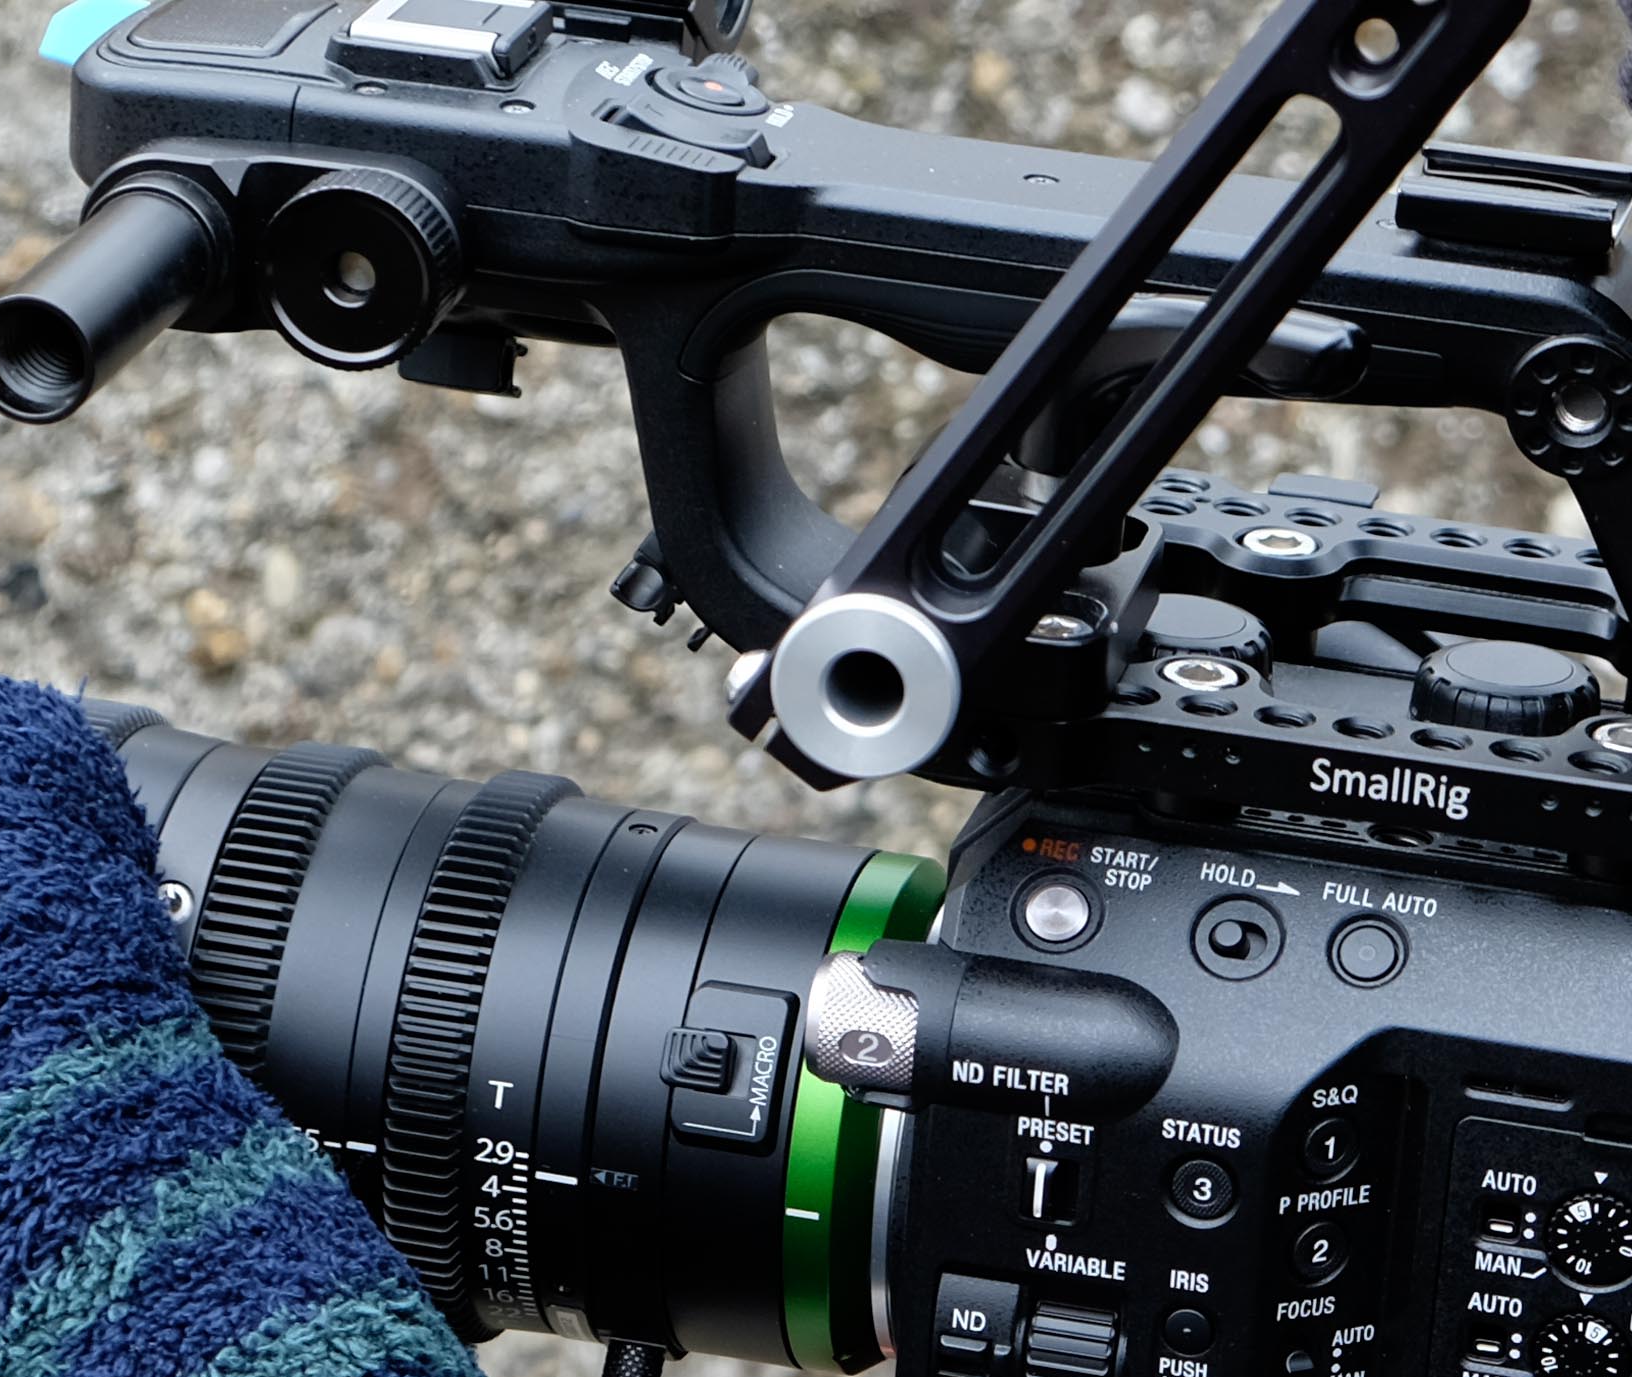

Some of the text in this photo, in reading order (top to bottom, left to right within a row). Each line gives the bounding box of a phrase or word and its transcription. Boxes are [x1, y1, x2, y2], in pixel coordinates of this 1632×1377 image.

[1309, 757, 1471, 820] SmallRig
[1039, 837, 1080, 861] REC
[1090, 846, 1159, 869] START/
[1104, 869, 1153, 892] STOP
[1200, 861, 1256, 888] HOLD
[1322, 881, 1438, 918] FULL AUTO
[857, 1033, 879, 1062] 2
[748, 1035, 777, 1106] MACRO
[952, 1061, 1069, 1096] ND FILTER
[487, 1079, 515, 1110] T
[1311, 1084, 1359, 1109] S&Q
[291, 1126, 321, 1153] 5
[1017, 1116, 1095, 1146] PRESET
[1161, 1118, 1241, 1149] STATUS
[1324, 1136, 1336, 1160] 1
[481, 1174, 501, 1198] 4
[1192, 1177, 1212, 1201] 3
[1481, 1169, 1537, 1196] AUTO
[1279, 1184, 1371, 1215] P PROFILE
[473, 1206, 514, 1231] 5.6
[485, 1238, 504, 1258] 8
[1311, 1239, 1329, 1263] 2
[477, 1263, 508, 1282] 11
[1026, 1249, 1126, 1281] VARIABLE
[1474, 1251, 1522, 1277] MAN
[1575, 1257, 1592, 1276] 10
[1169, 1269, 1209, 1293] IRIS
[483, 1288, 514, 1303] 16
[1467, 1291, 1523, 1318] AUTO
[951, 1309, 987, 1332] ND
[1276, 1295, 1336, 1322] FOCUS
[1331, 1324, 1375, 1347] AUTO
